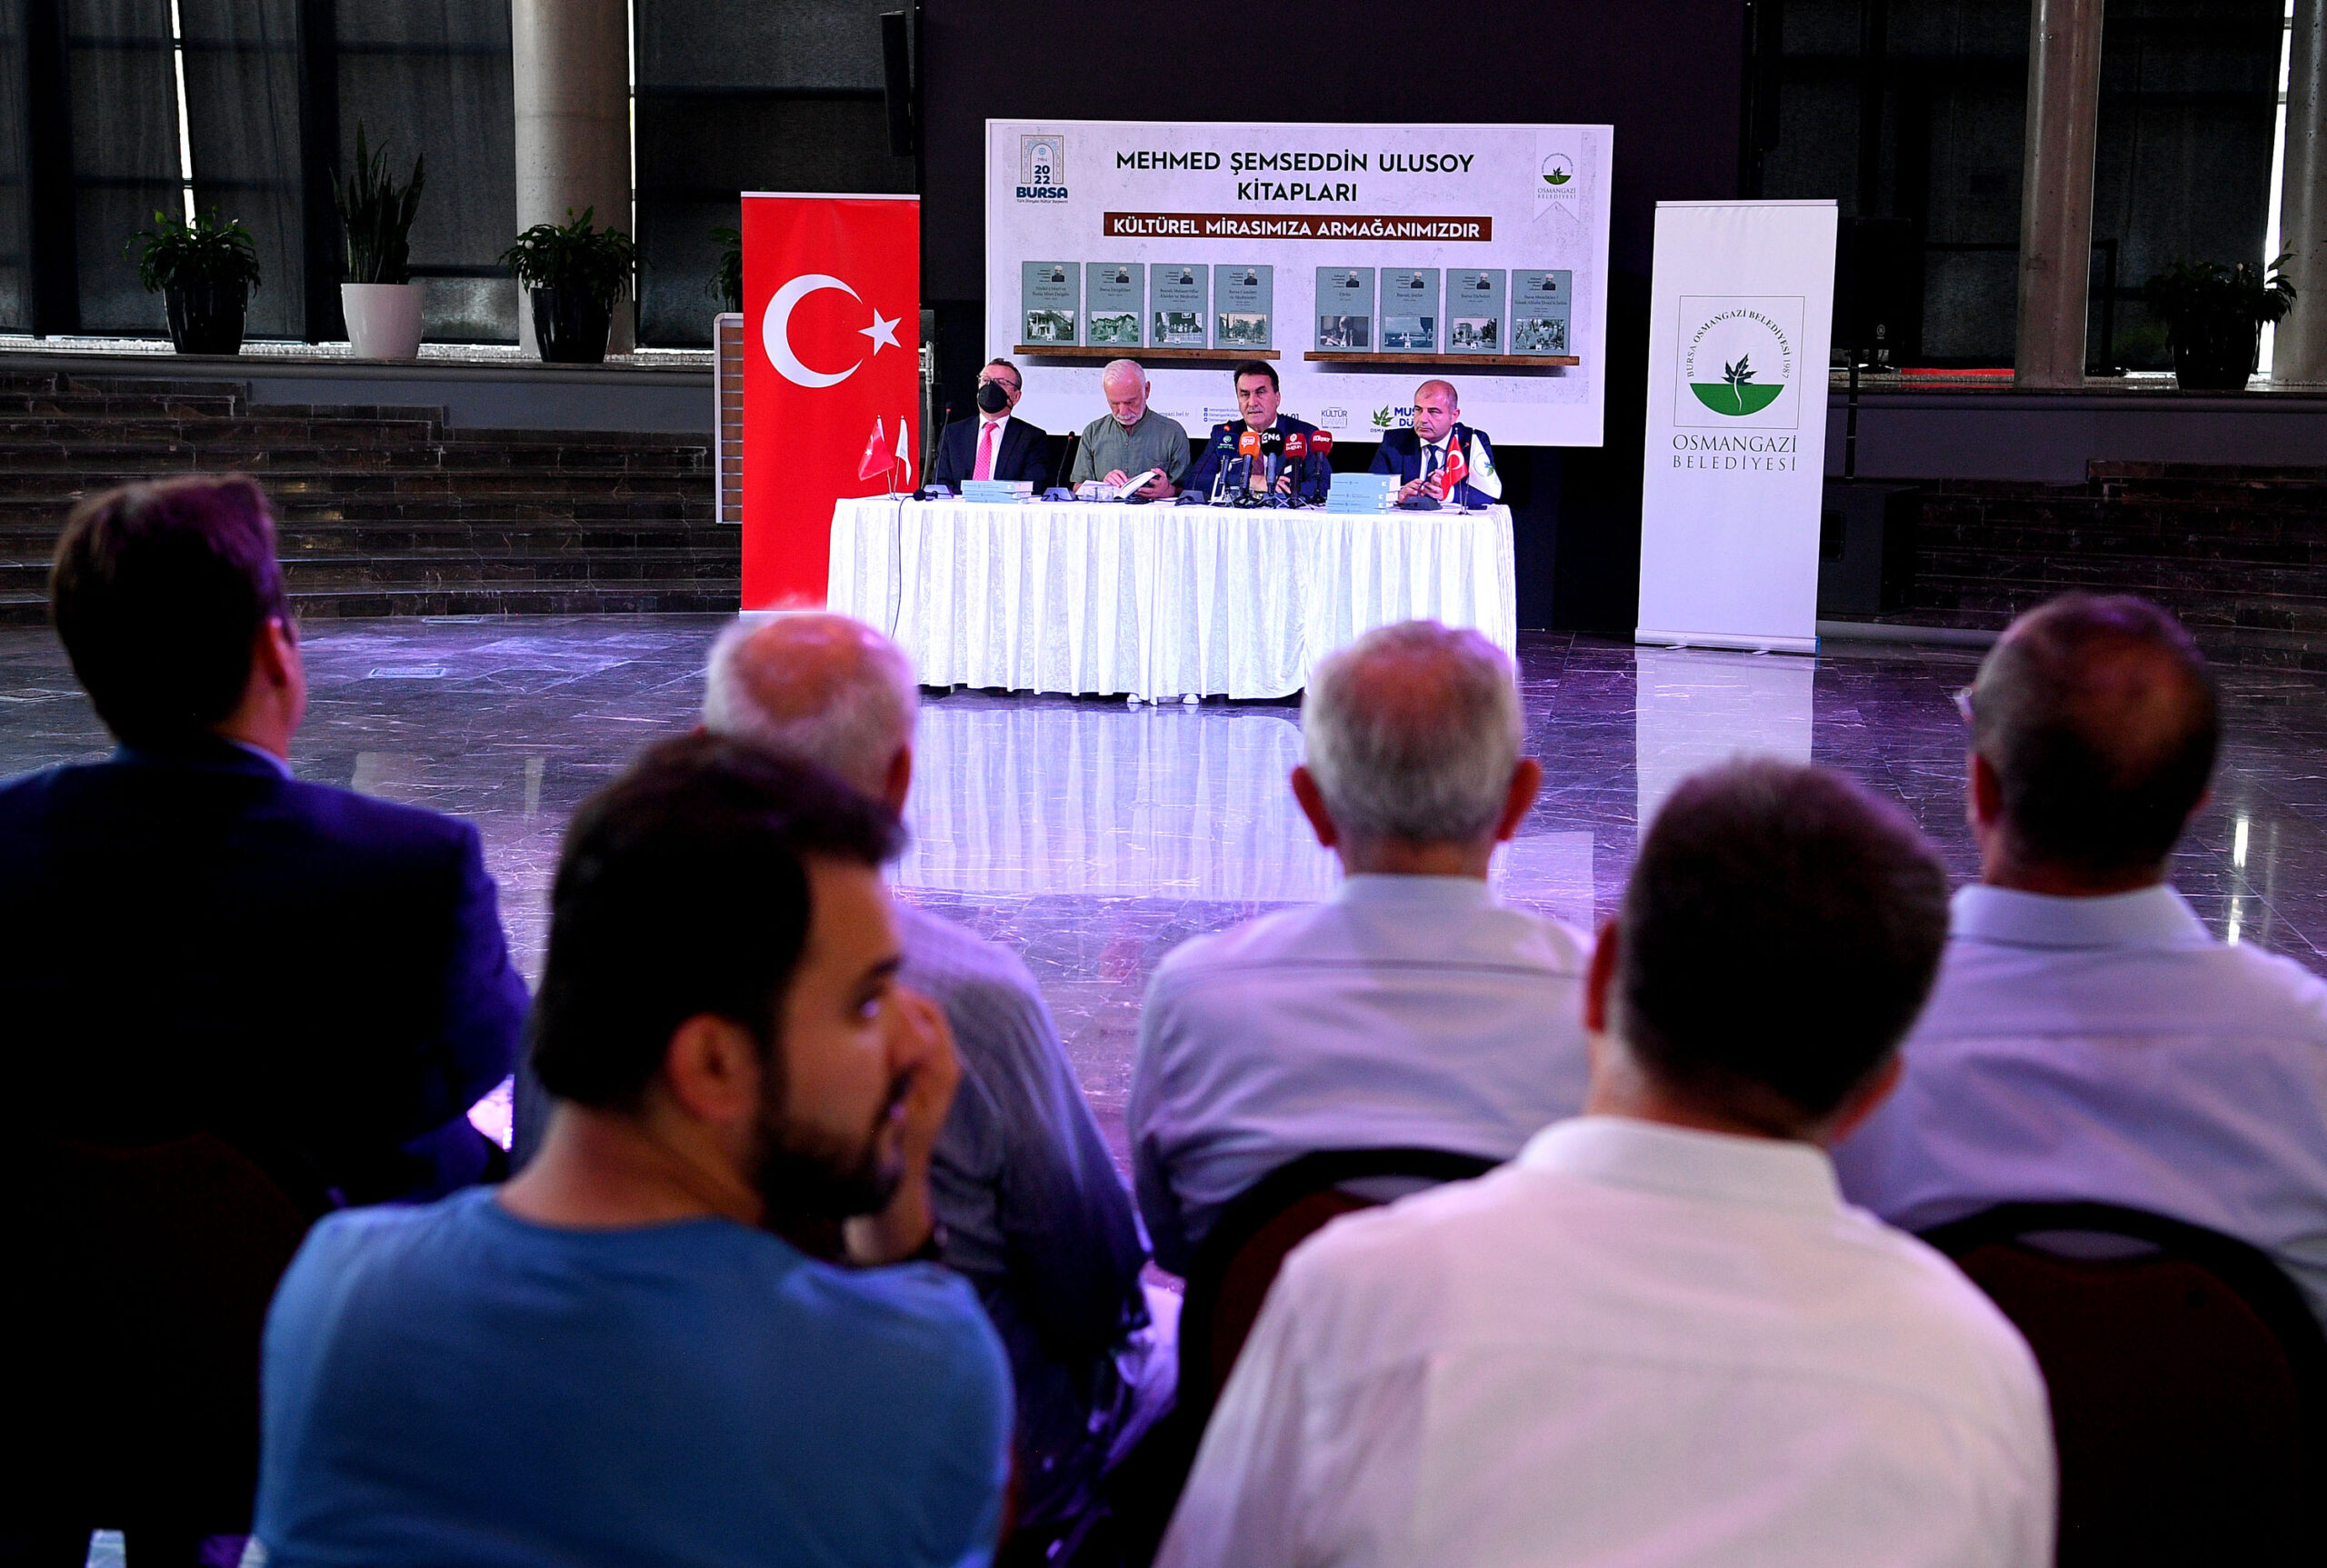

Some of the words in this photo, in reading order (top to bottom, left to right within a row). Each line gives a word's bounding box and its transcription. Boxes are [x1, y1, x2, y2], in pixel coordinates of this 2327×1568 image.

[1034, 165, 1050, 175] 20
[1116, 151, 1221, 170] MEHMED
[1230, 149, 1367, 175] ŞEMSEDDİN
[1379, 154, 1474, 173] ULUSOY
[1034, 175, 1050, 185] 22
[1016, 186, 1068, 199] BURSA
[1237, 178, 1357, 202] KİTAPLARI
[1114, 215, 1200, 235] KÜLTÜREL
[1205, 216, 1312, 236] MİRASIMIZA
[1317, 218, 1480, 238] ARMAĞANIMIZDIR
[1686, 345, 1697, 377] BURSA
[1693, 308, 1746, 343] OSMANGAZİ
[1749, 310, 1792, 356] BELEDİYESİ
[1782, 359, 1791, 379] 1987
[1321, 409, 1348, 418] KÜLTÜR
[1673, 434, 1796, 453] OSMANGAZİ
[1673, 454, 1795, 472] BELEDİYESİ
